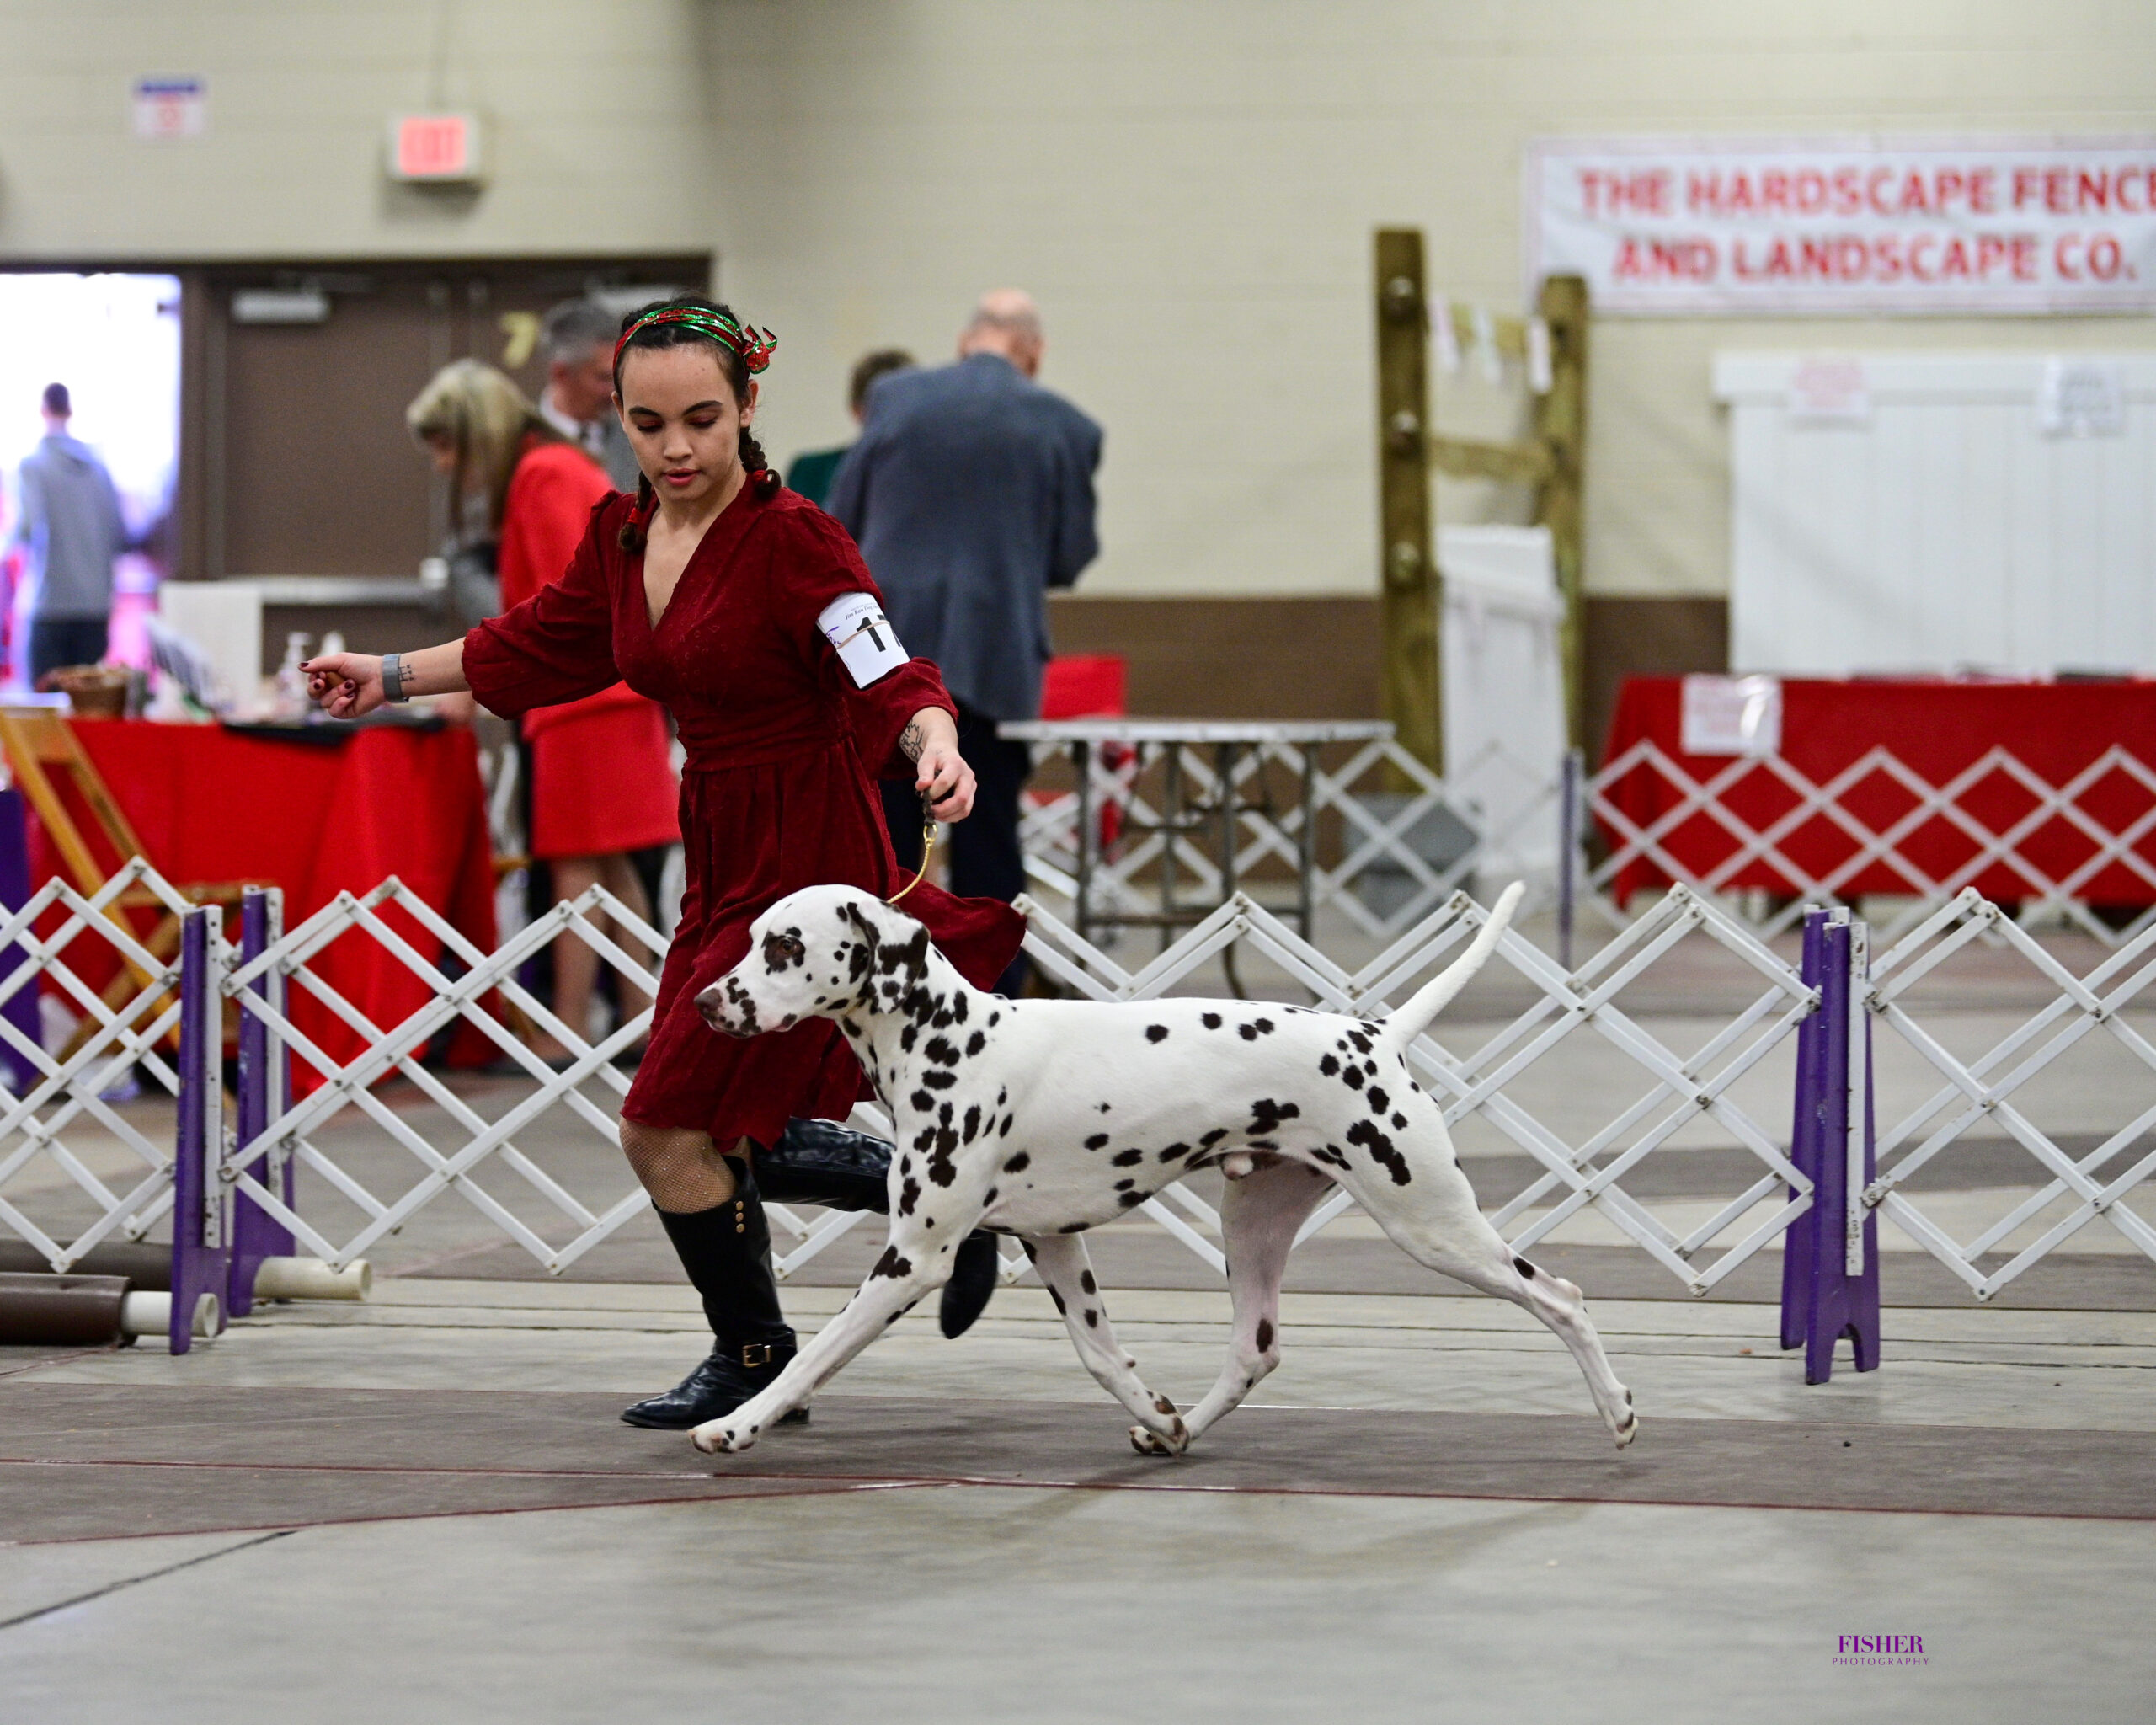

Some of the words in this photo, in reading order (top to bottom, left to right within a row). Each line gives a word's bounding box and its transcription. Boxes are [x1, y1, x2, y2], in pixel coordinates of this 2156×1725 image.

[1577, 168, 1671, 216] THE
[1687, 168, 1997, 216] HARDSCAPE
[1614, 235, 1719, 282] AND
[1732, 234, 2039, 283] LANDSCAPE
[2055, 233, 2138, 282] CO.
